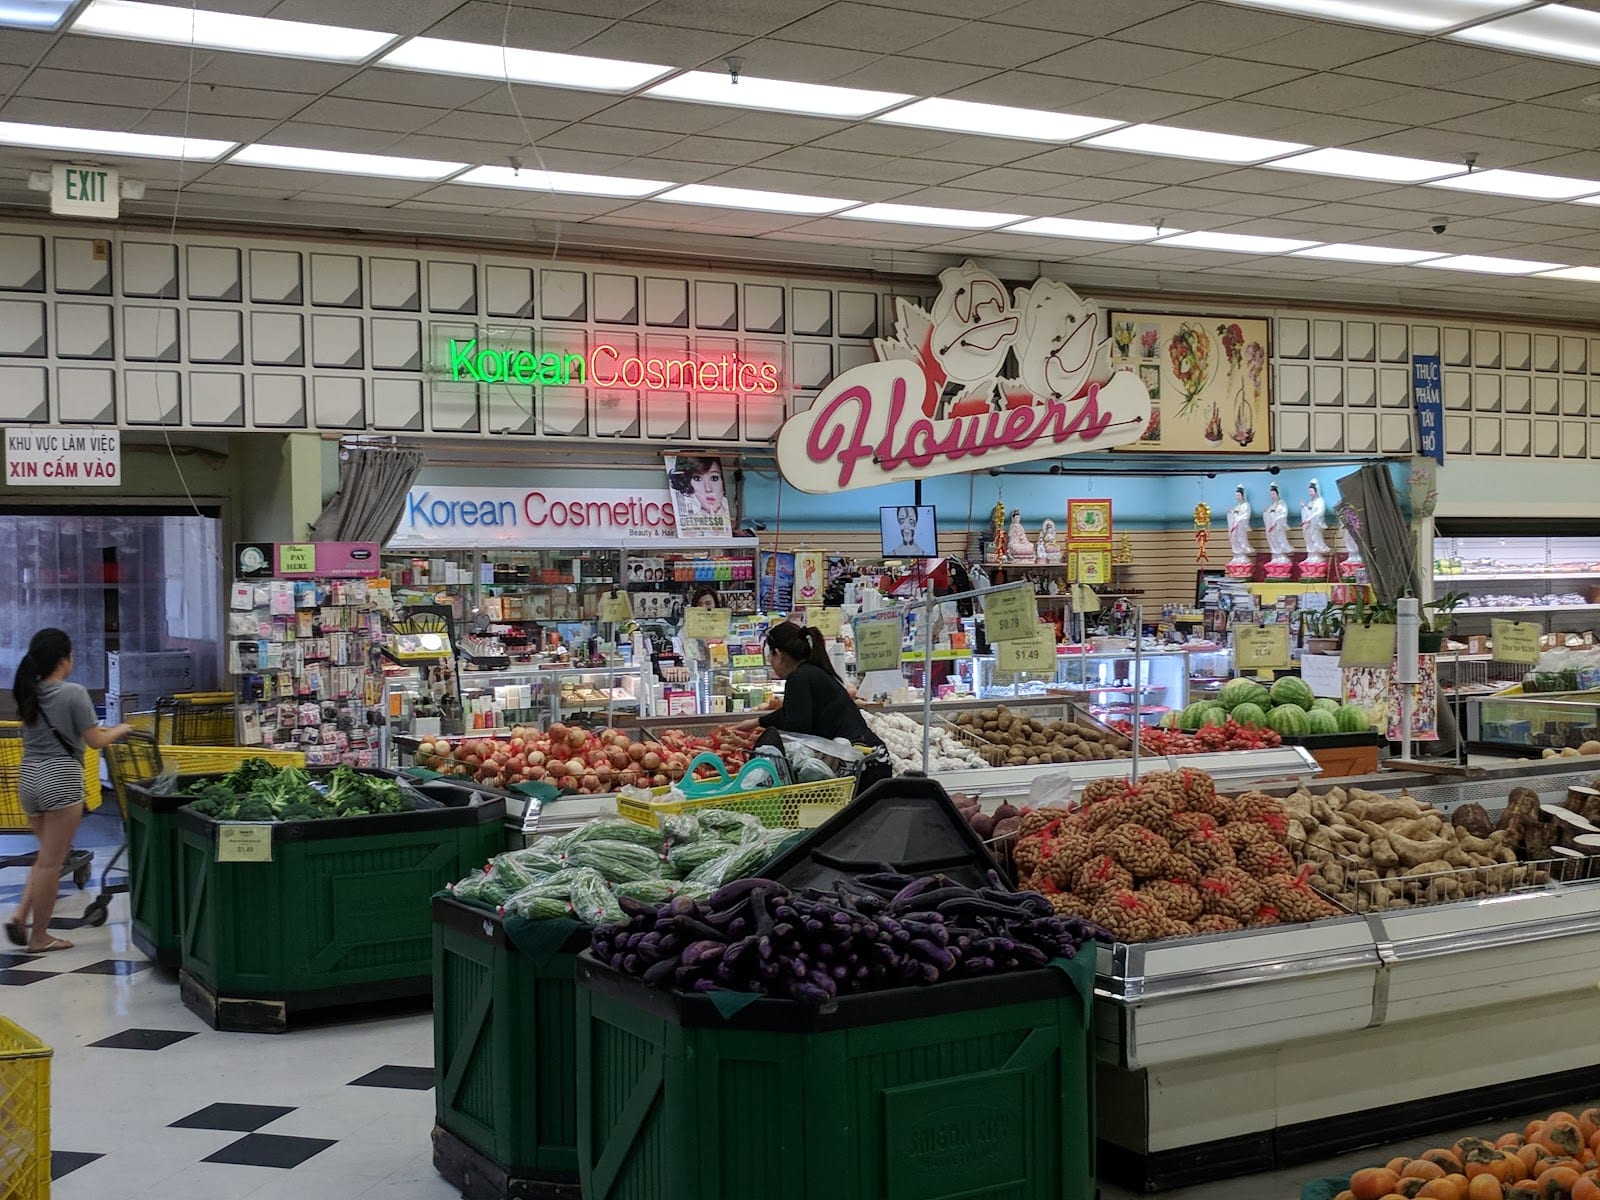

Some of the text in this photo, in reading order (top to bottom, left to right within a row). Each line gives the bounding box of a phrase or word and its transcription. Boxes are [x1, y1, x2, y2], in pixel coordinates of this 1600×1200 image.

[66, 169, 108, 202] EXIT
[450, 338, 778, 394] Korean Cosmetics
[1415, 362, 1438, 382] THỰC
[1421, 409, 1435, 427] TÂY
[807, 376, 1112, 488] Flowers
[9, 433, 115, 454] KHU VỰC LÀM VIỆC
[10, 455, 116, 478] XIN CẤM VÀO
[409, 491, 517, 528] Korean
[524, 491, 676, 528] Cosmetics
[629, 529, 652, 538] Beauty
[877, 611, 898, 620] SPECIAL
[999, 617, 1019, 631] $0.79
[1015, 649, 1039, 660] $1.49
